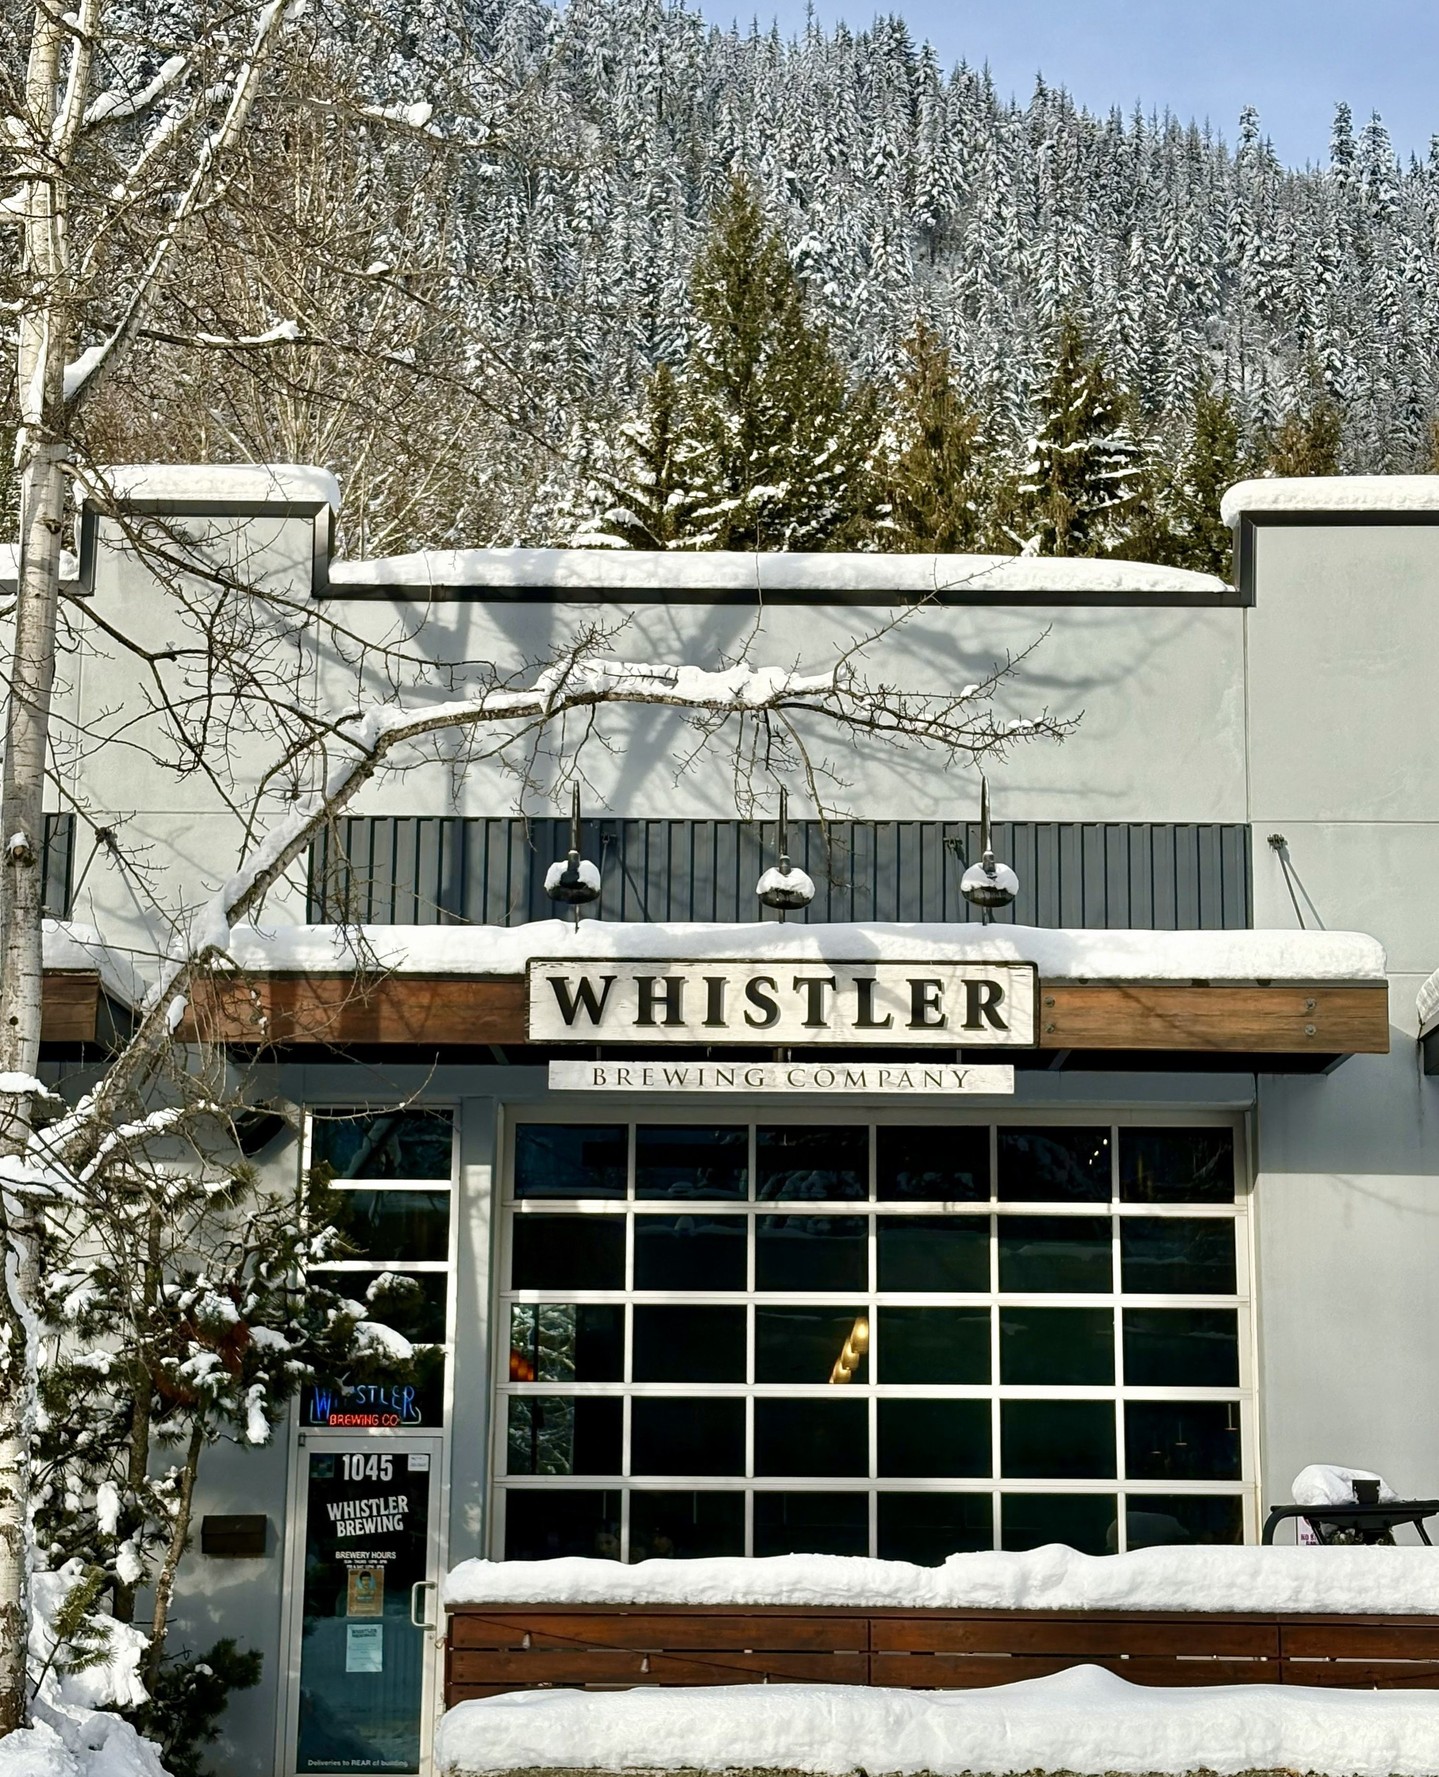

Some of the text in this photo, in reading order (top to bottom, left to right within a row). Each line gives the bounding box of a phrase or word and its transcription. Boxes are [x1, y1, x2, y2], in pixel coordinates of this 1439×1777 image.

[546, 975, 1011, 1032] WHISTLER
[592, 1067, 971, 1089] BREWING COMPANY
[314, 1384, 416, 1419] WSTLER
[342, 1453, 393, 1481] 1045
[327, 1495, 409, 1521] WHISTLER
[336, 1514, 404, 1537] BREWING
[335, 1551, 396, 1559] BREWERY HOURS
[351, 1759, 371, 1767] REAR
[372, 1759, 380, 1767] of
